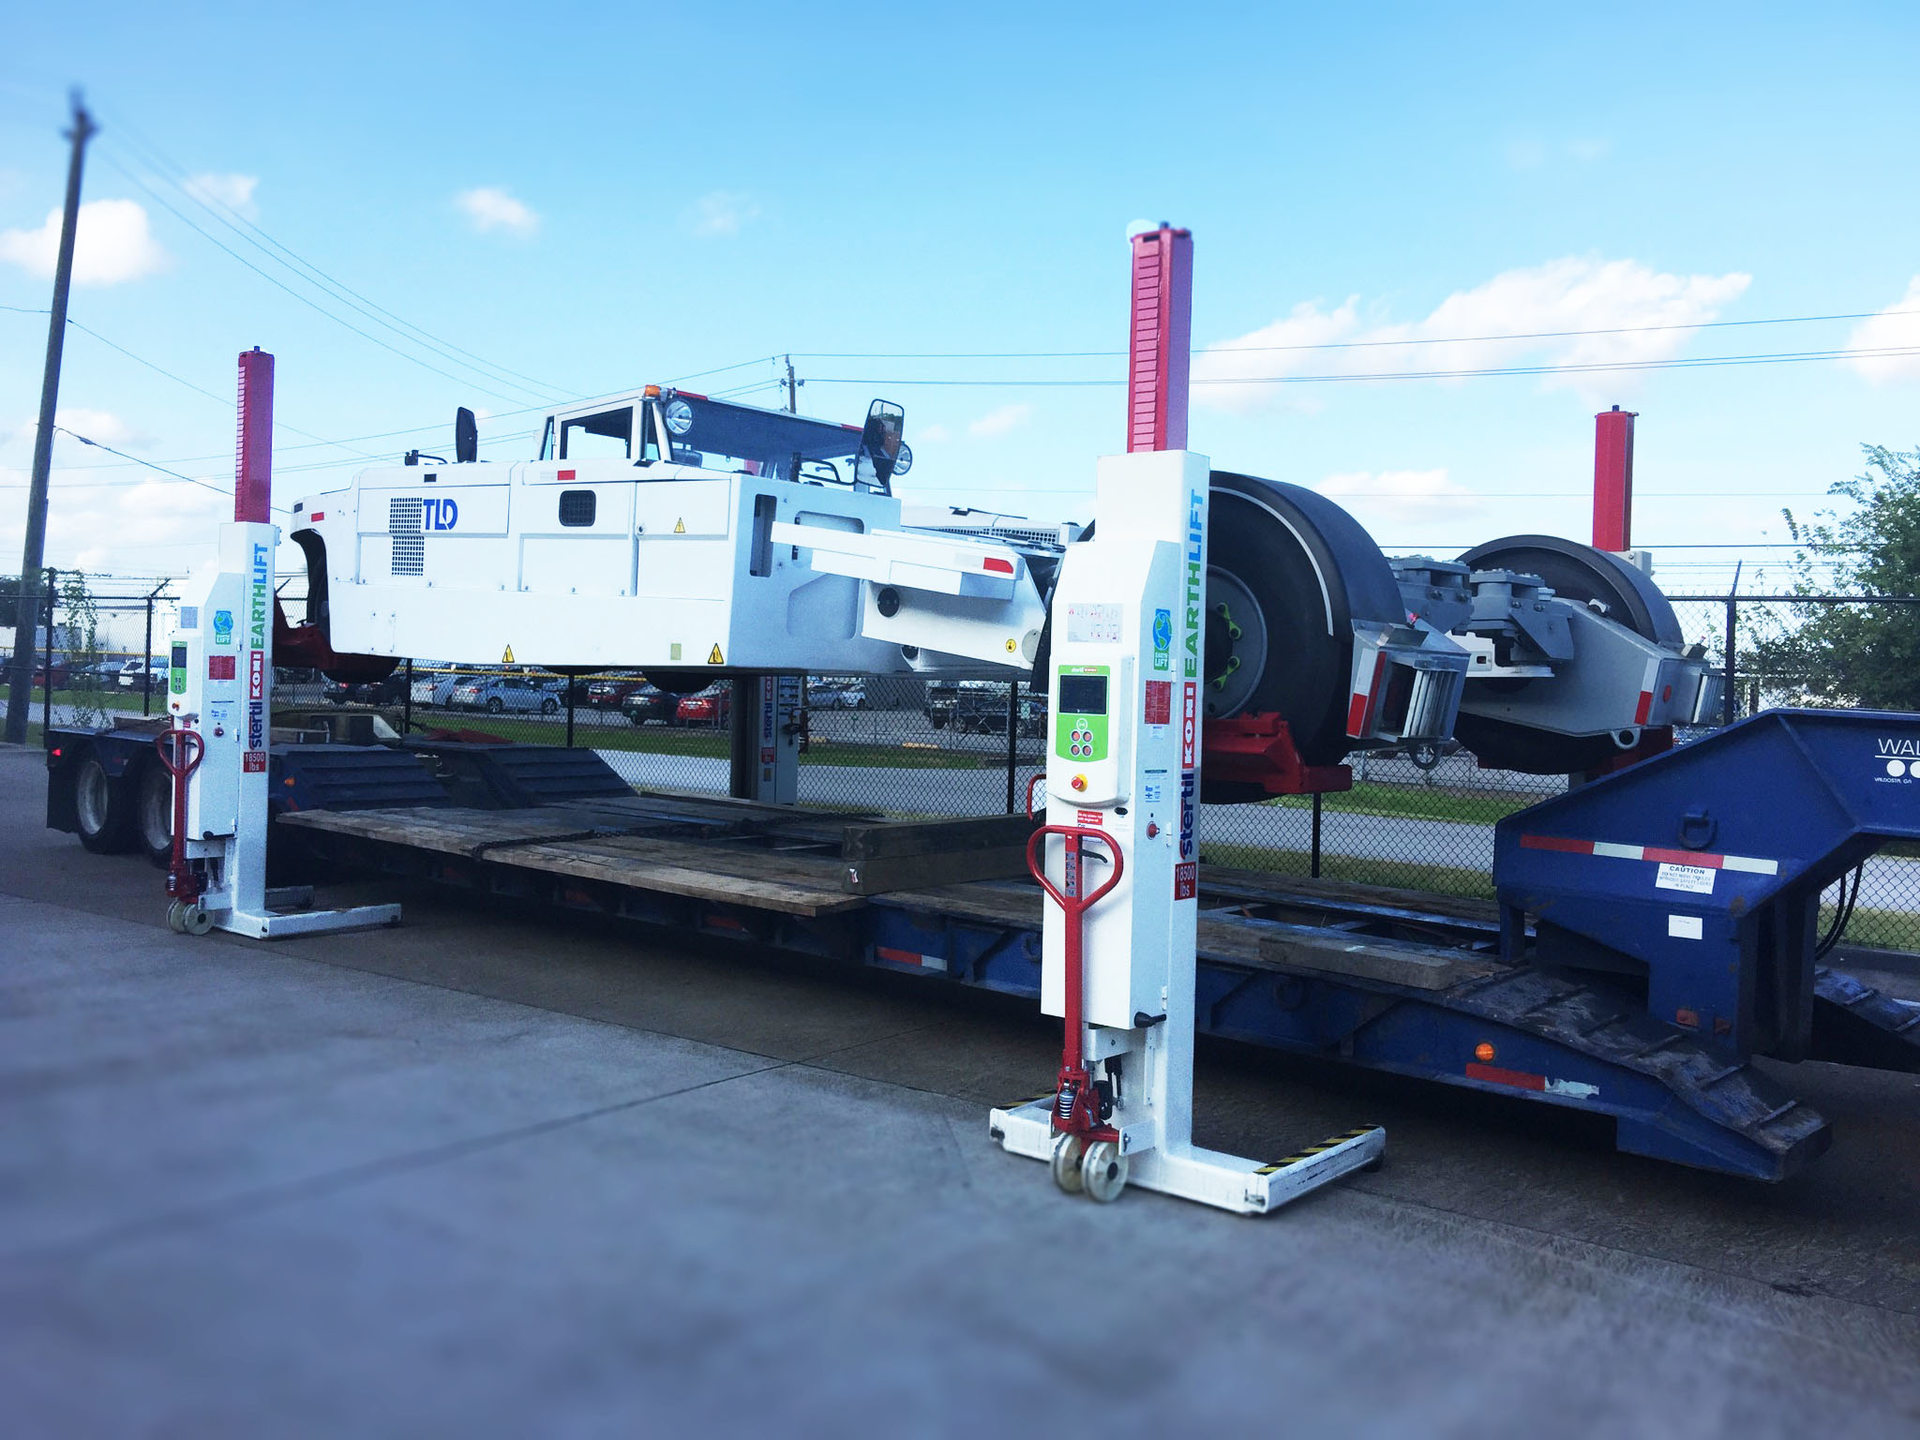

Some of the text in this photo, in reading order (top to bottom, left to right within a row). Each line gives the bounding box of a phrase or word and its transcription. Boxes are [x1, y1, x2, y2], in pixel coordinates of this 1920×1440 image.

[423, 499, 458, 530] TLD
[249, 543, 268, 749] stertil KONI EARTHLIFT
[1155, 658, 1168, 667] LIFT
[1180, 489, 1203, 858] stertil KONI EARTHLIFT
[244, 754, 265, 762] 18500
[248, 763, 260, 771] lbs
[1176, 865, 1195, 881] 18500
[1669, 866, 1705, 875] CAUTION
[1179, 882, 1190, 896] lbs
